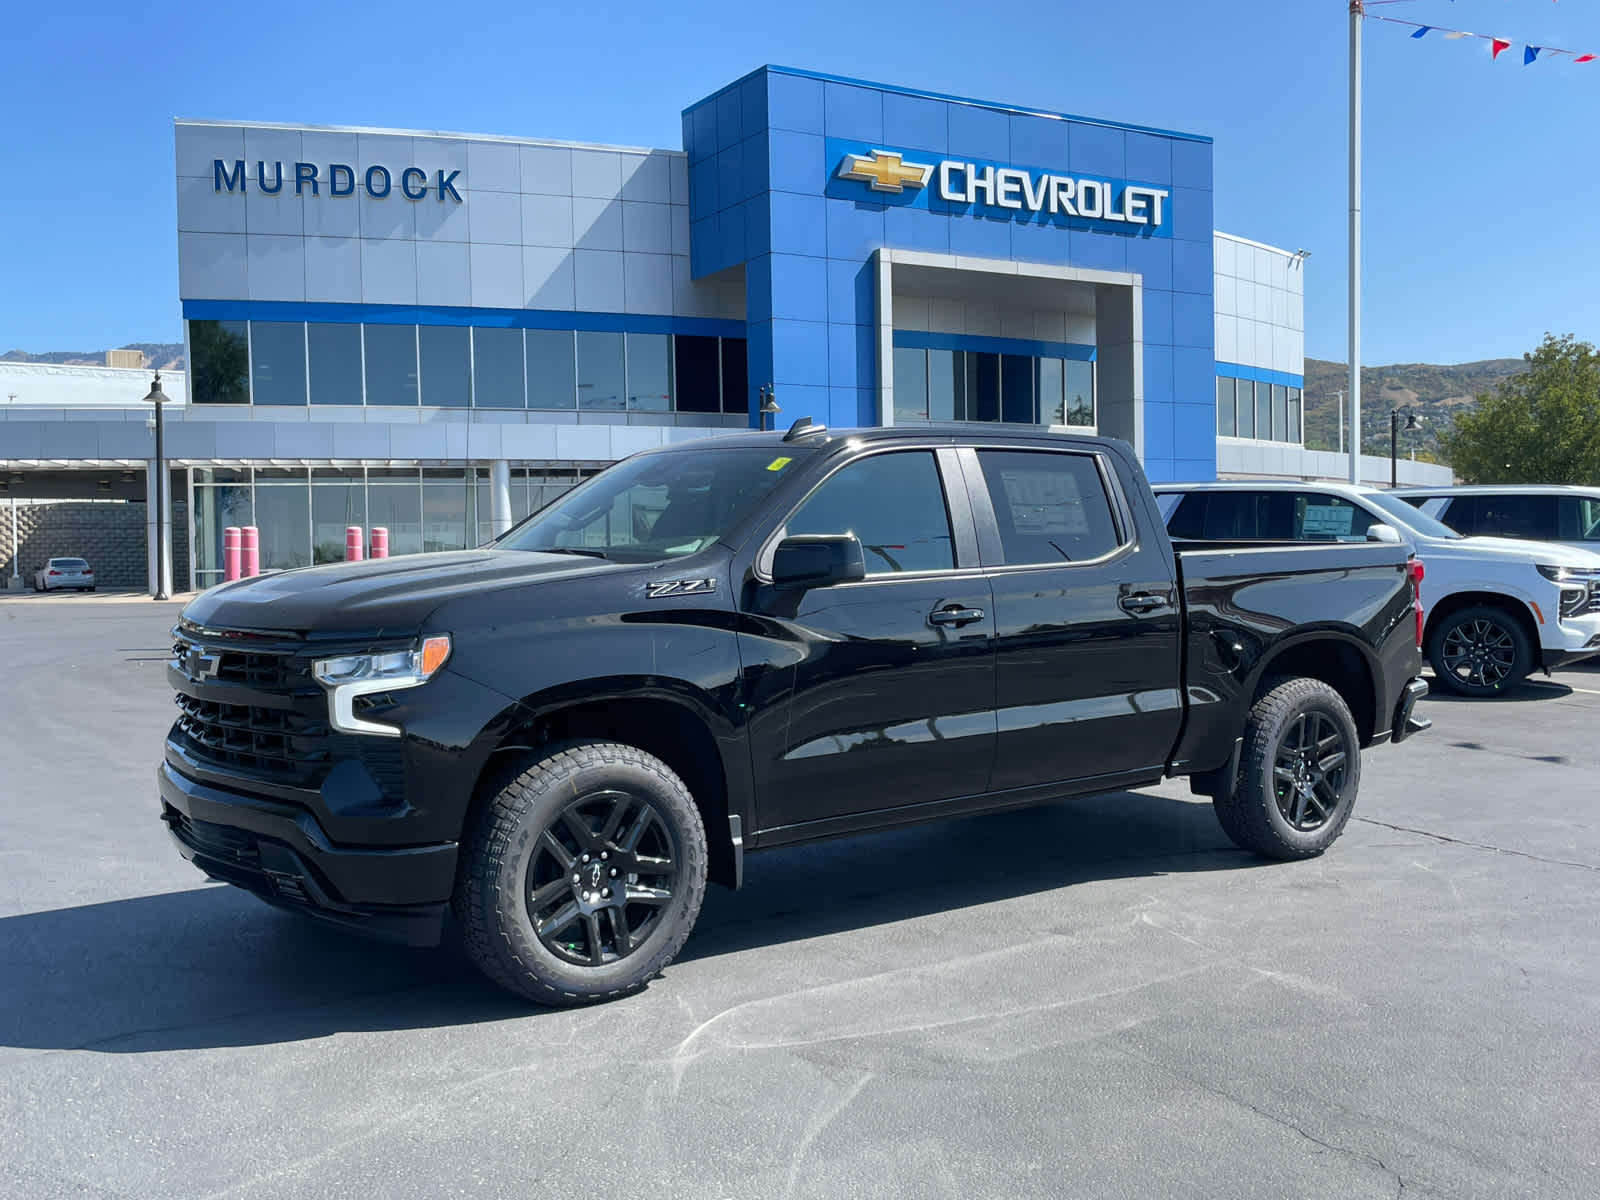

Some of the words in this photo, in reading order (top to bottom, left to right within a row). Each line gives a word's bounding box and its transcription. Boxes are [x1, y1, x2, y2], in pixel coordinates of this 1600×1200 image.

[213, 159, 464, 203] MURDOCK
[939, 160, 1168, 226] CHEVROLET
[647, 578, 717, 599] Z71
